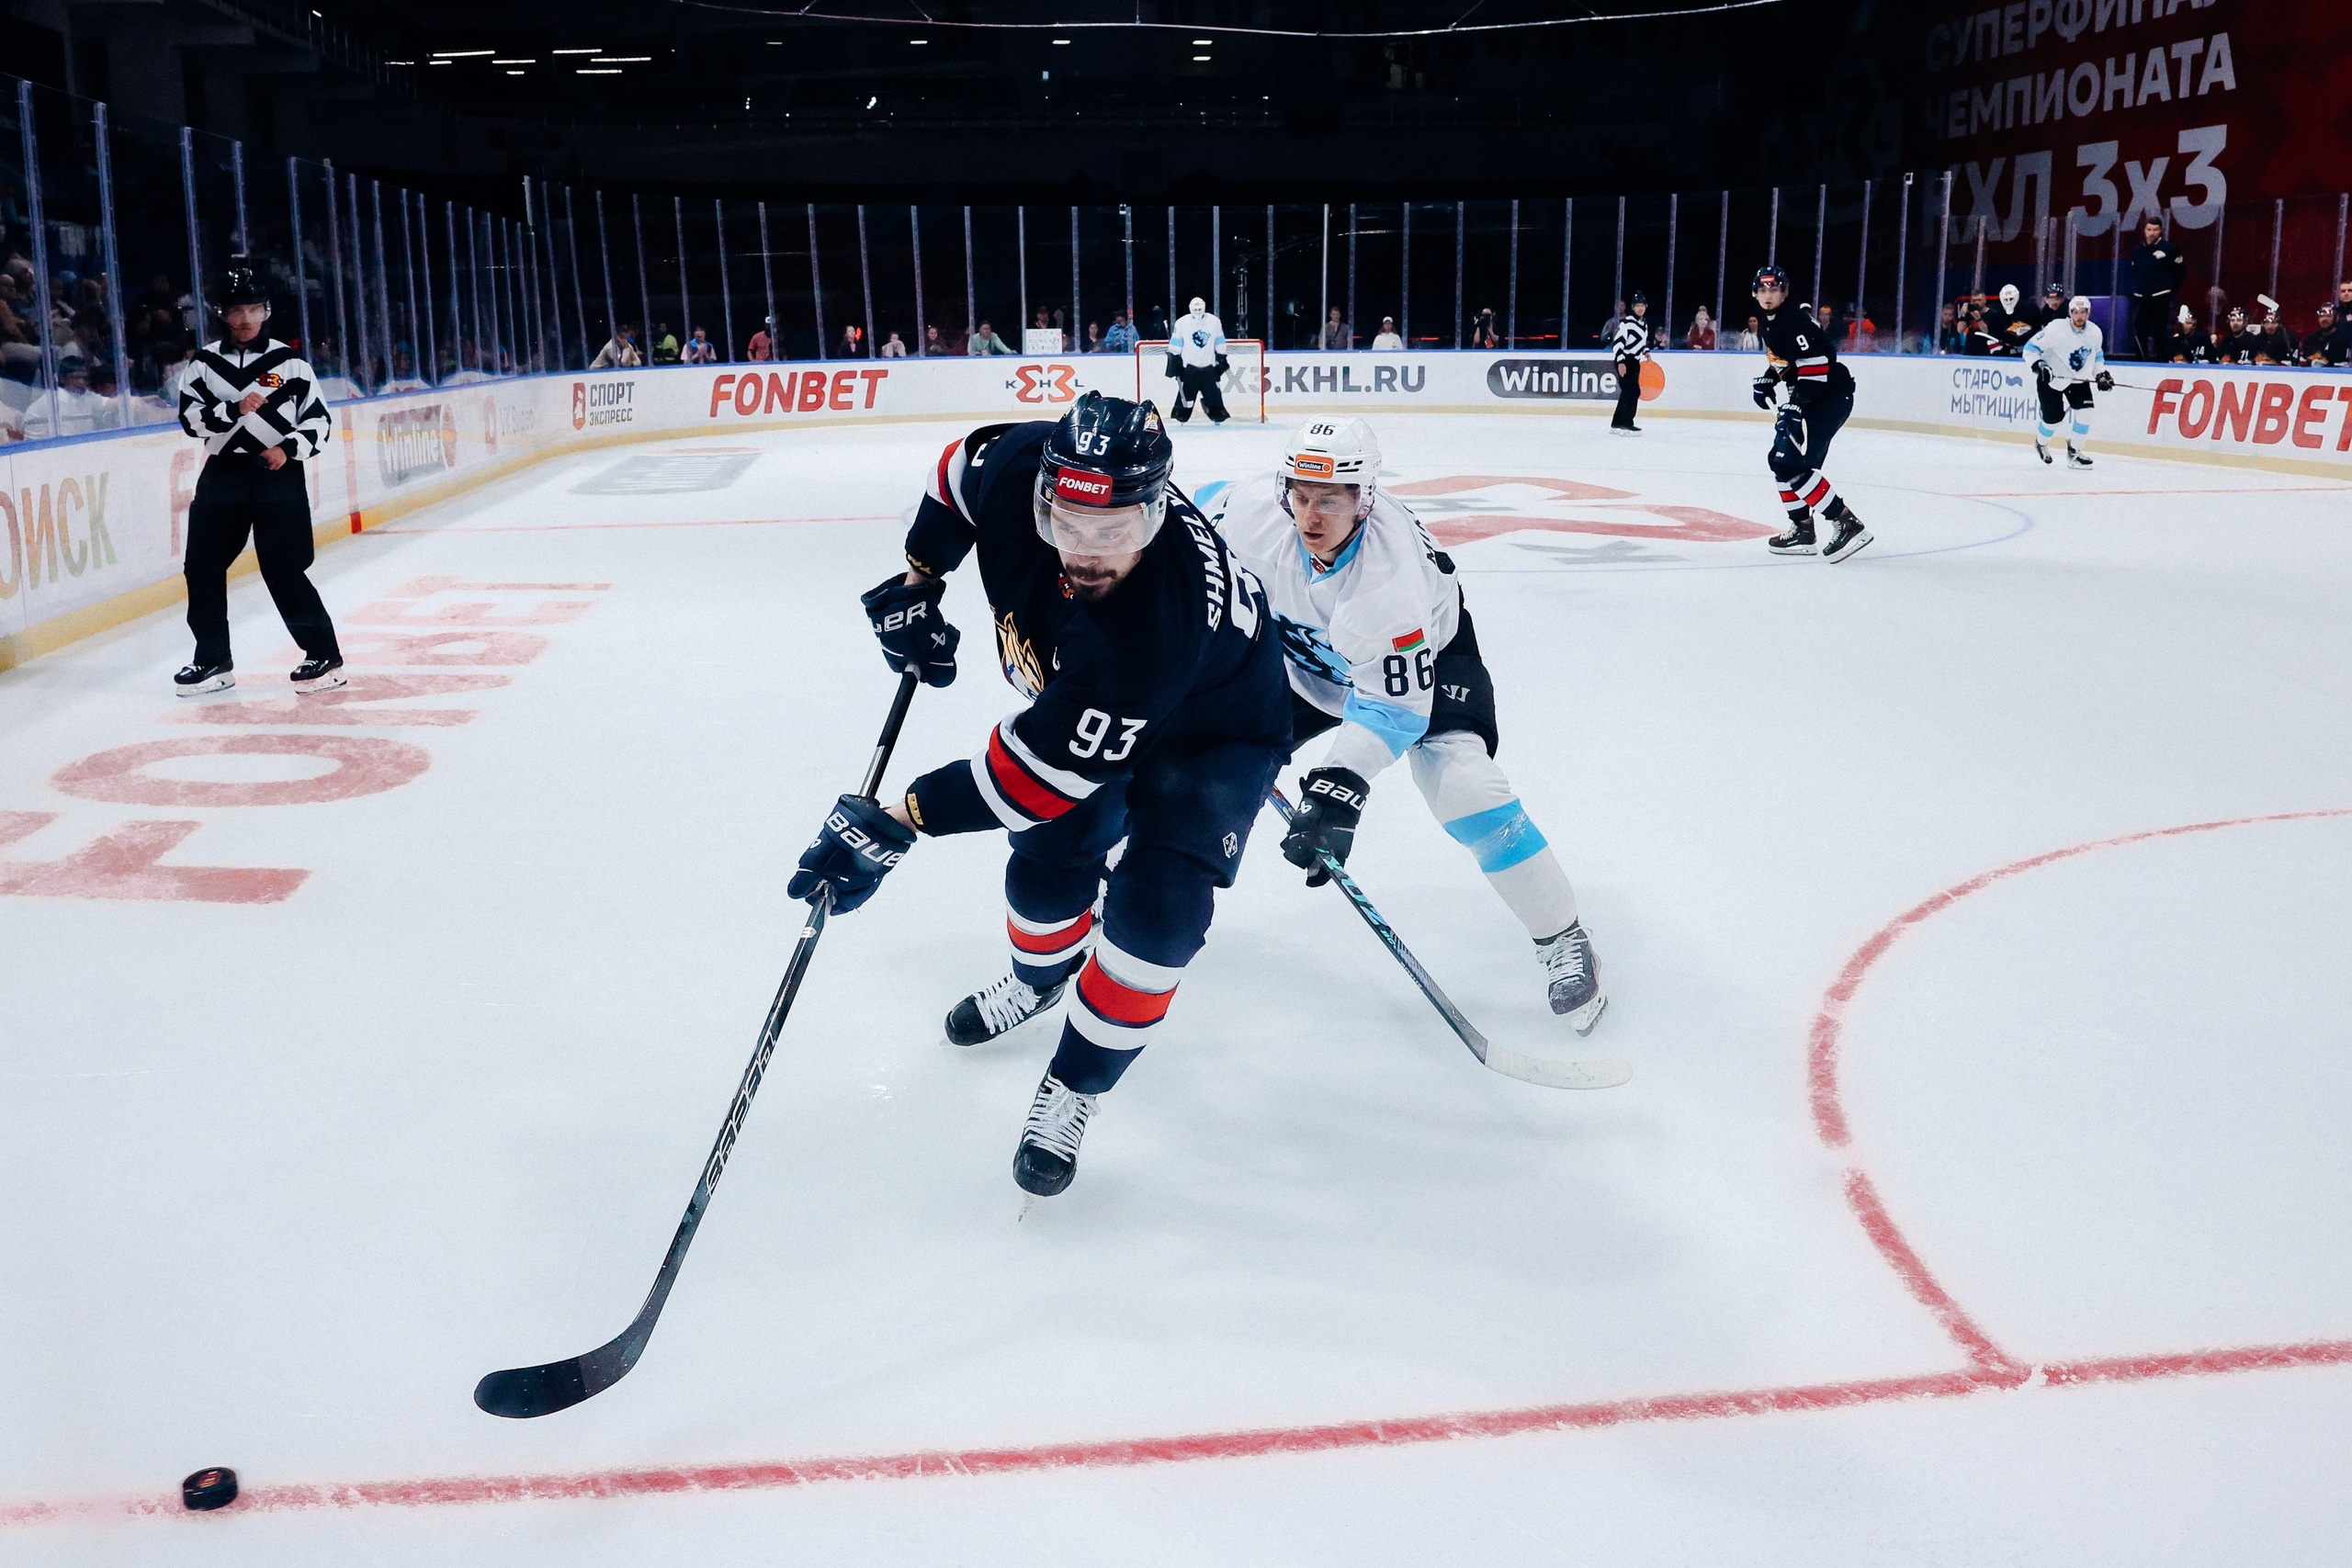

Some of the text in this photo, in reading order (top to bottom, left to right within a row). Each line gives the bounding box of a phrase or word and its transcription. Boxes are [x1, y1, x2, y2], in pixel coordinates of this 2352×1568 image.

[1928, 0, 2215, 72] СУПЕРФИН
[1925, 32, 2237, 139] ЧЕМПИОНАТА
[1922, 150, 2053, 246] КХЛ
[1796, 334, 1810, 351] 9
[1498, 366, 1618, 393] Winline
[1952, 368, 2002, 390] СТАРО
[589, 381, 635, 407] СПОРТ
[709, 369, 888, 418] FONBET
[589, 408, 633, 426] ЭКСПРЕСС
[1951, 394, 2073, 423] МЫТИЩИН
[2147, 378, 2352, 452] FONBET
[1309, 423, 1336, 435] 86
[1078, 431, 1111, 457] 93
[1298, 460, 1322, 470] Winline
[1058, 477, 1110, 495] FONBET
[1383, 648, 1434, 696] 86
[1069, 707, 1148, 761] 93
